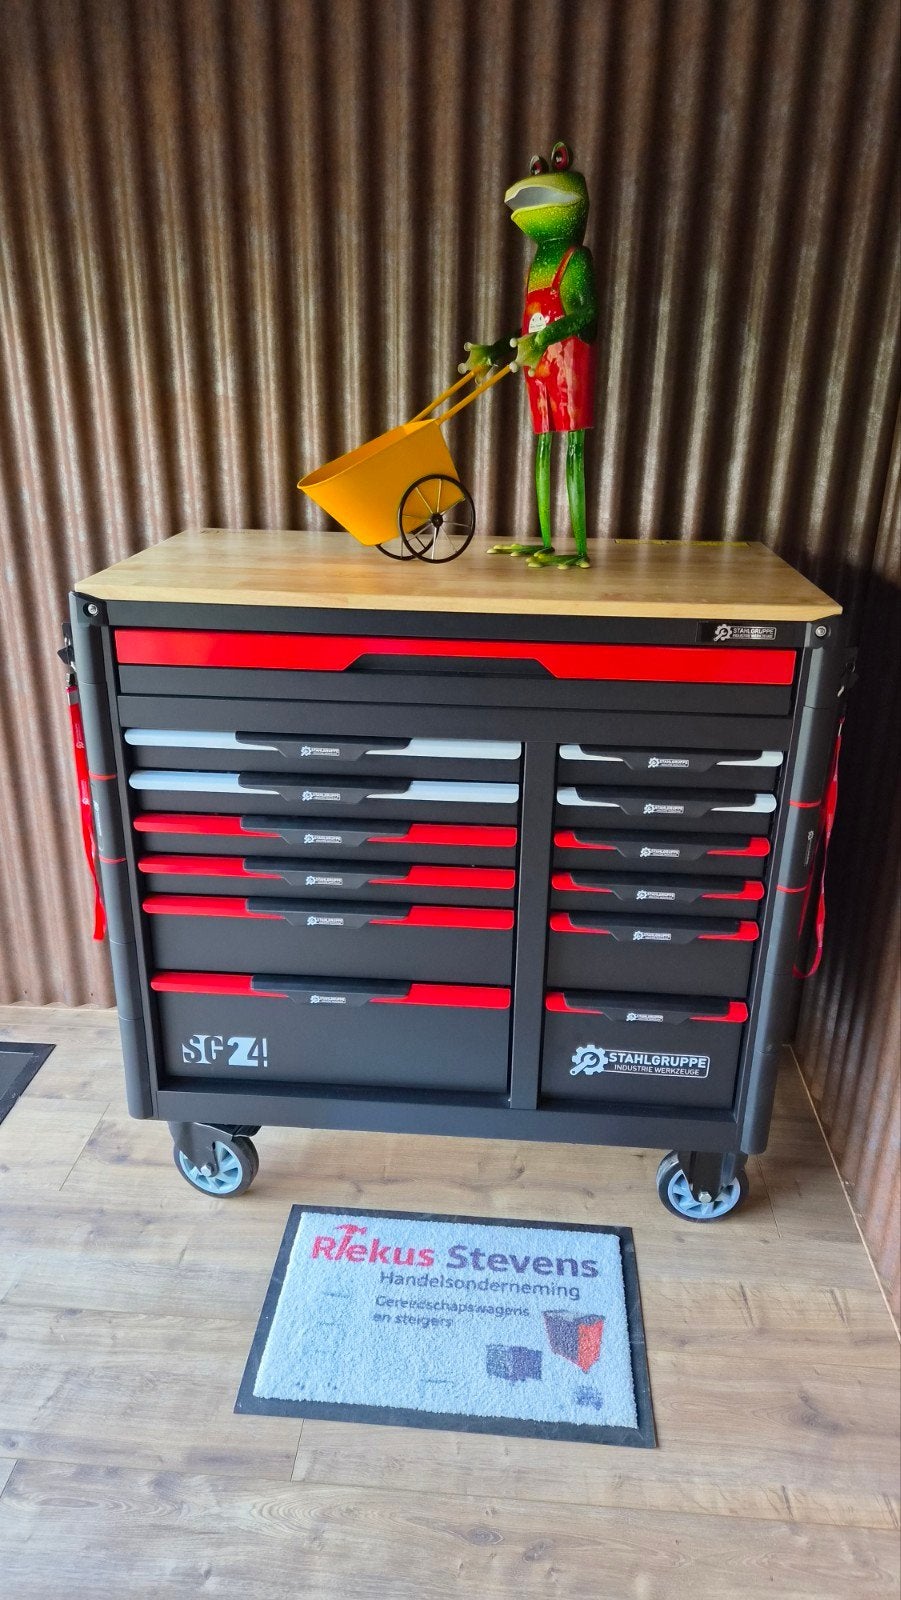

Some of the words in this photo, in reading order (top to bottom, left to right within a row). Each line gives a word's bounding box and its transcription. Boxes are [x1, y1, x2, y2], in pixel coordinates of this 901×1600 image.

[732, 627, 774, 635] STAHLGRUPPE
[608, 1052, 707, 1069] STAHLGRUPPE
[614, 1064, 653, 1073] INDUSTRIE
[654, 1066, 700, 1076] WERKZEUGE
[311, 1224, 435, 1267] Riekus
[446, 1244, 600, 1278] Stevens
[379, 1271, 580, 1301] Handelsonderneming
[372, 1312, 391, 1323] en
[395, 1312, 454, 1329] steigers
